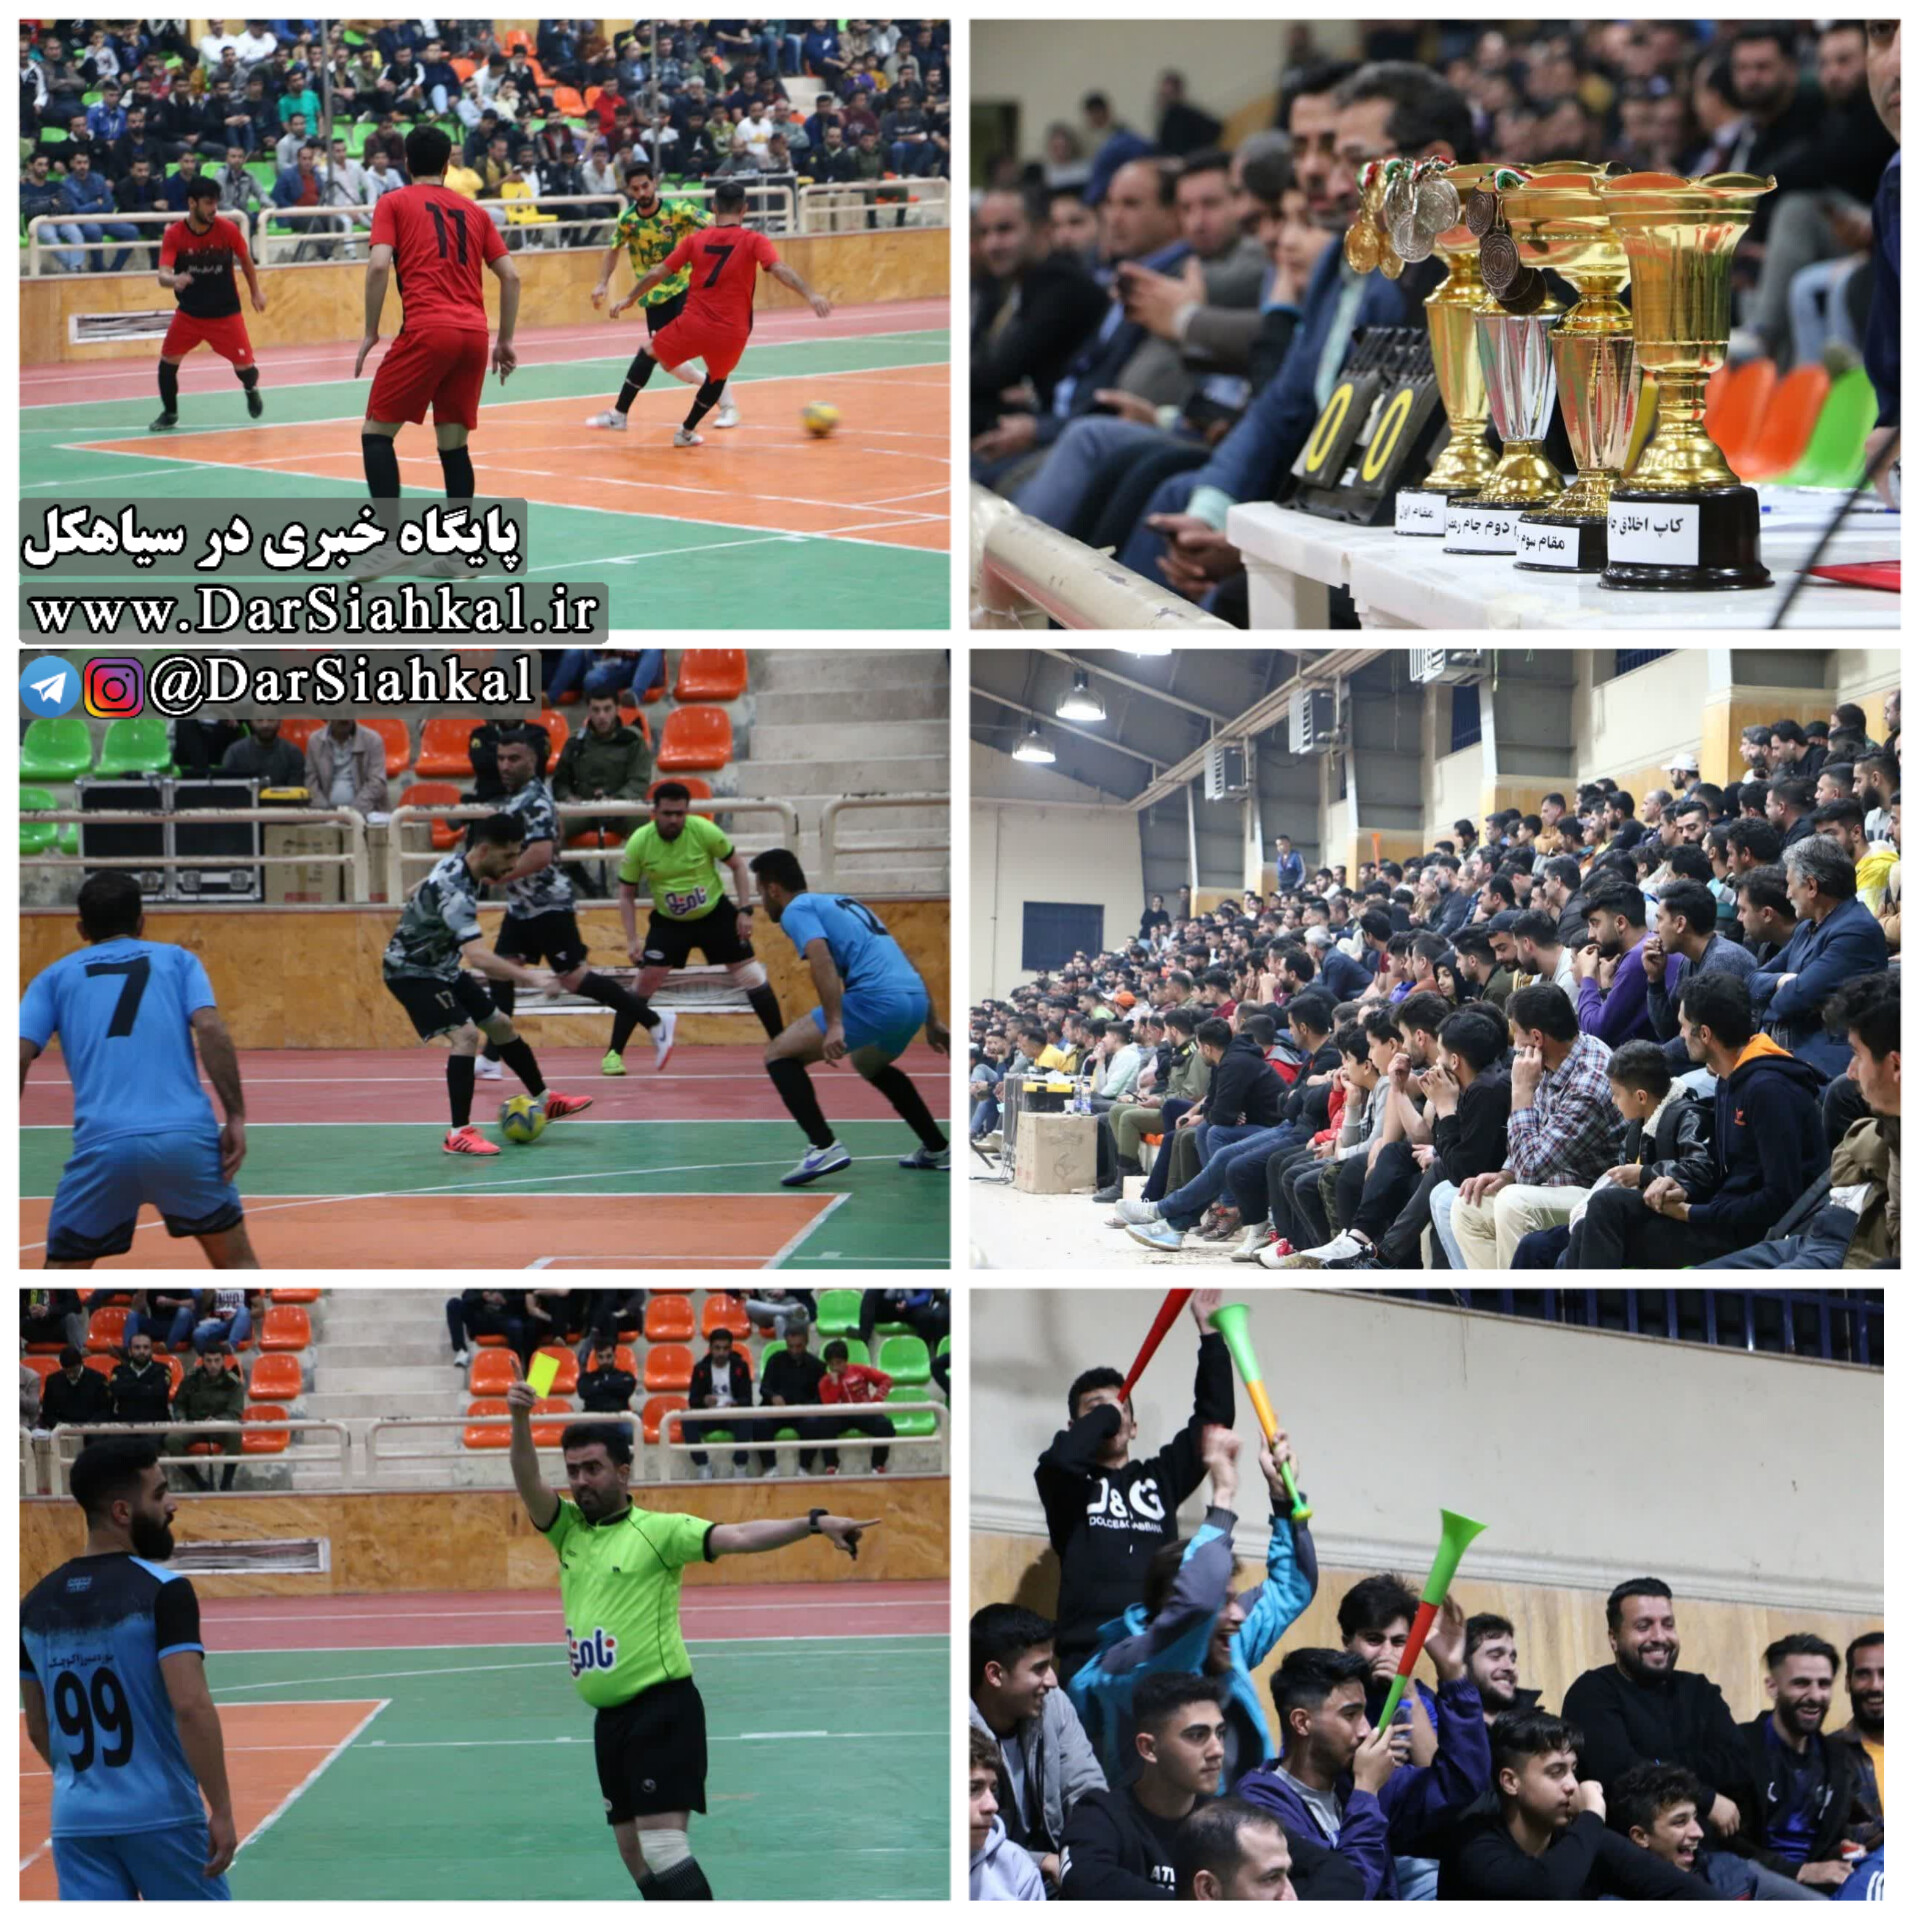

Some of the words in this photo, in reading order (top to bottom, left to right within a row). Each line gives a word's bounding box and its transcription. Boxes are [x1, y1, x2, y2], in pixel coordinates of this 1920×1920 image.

[425, 202, 468, 266] 11
[703, 244, 736, 289] 7
[1306, 382, 1354, 472] 0
[1362, 388, 1413, 482] 0
[1463, 517, 1482, 535] جام
[1484, 520, 1510, 537] دوم
[1619, 515, 1649, 536] اخلاق
[1653, 517, 1685, 539] کاپ
[1538, 535, 1566, 552] مقام
[85, 956, 151, 1039] 7
[435, 990, 457, 1010] 17
[54, 1666, 134, 1772] 99
